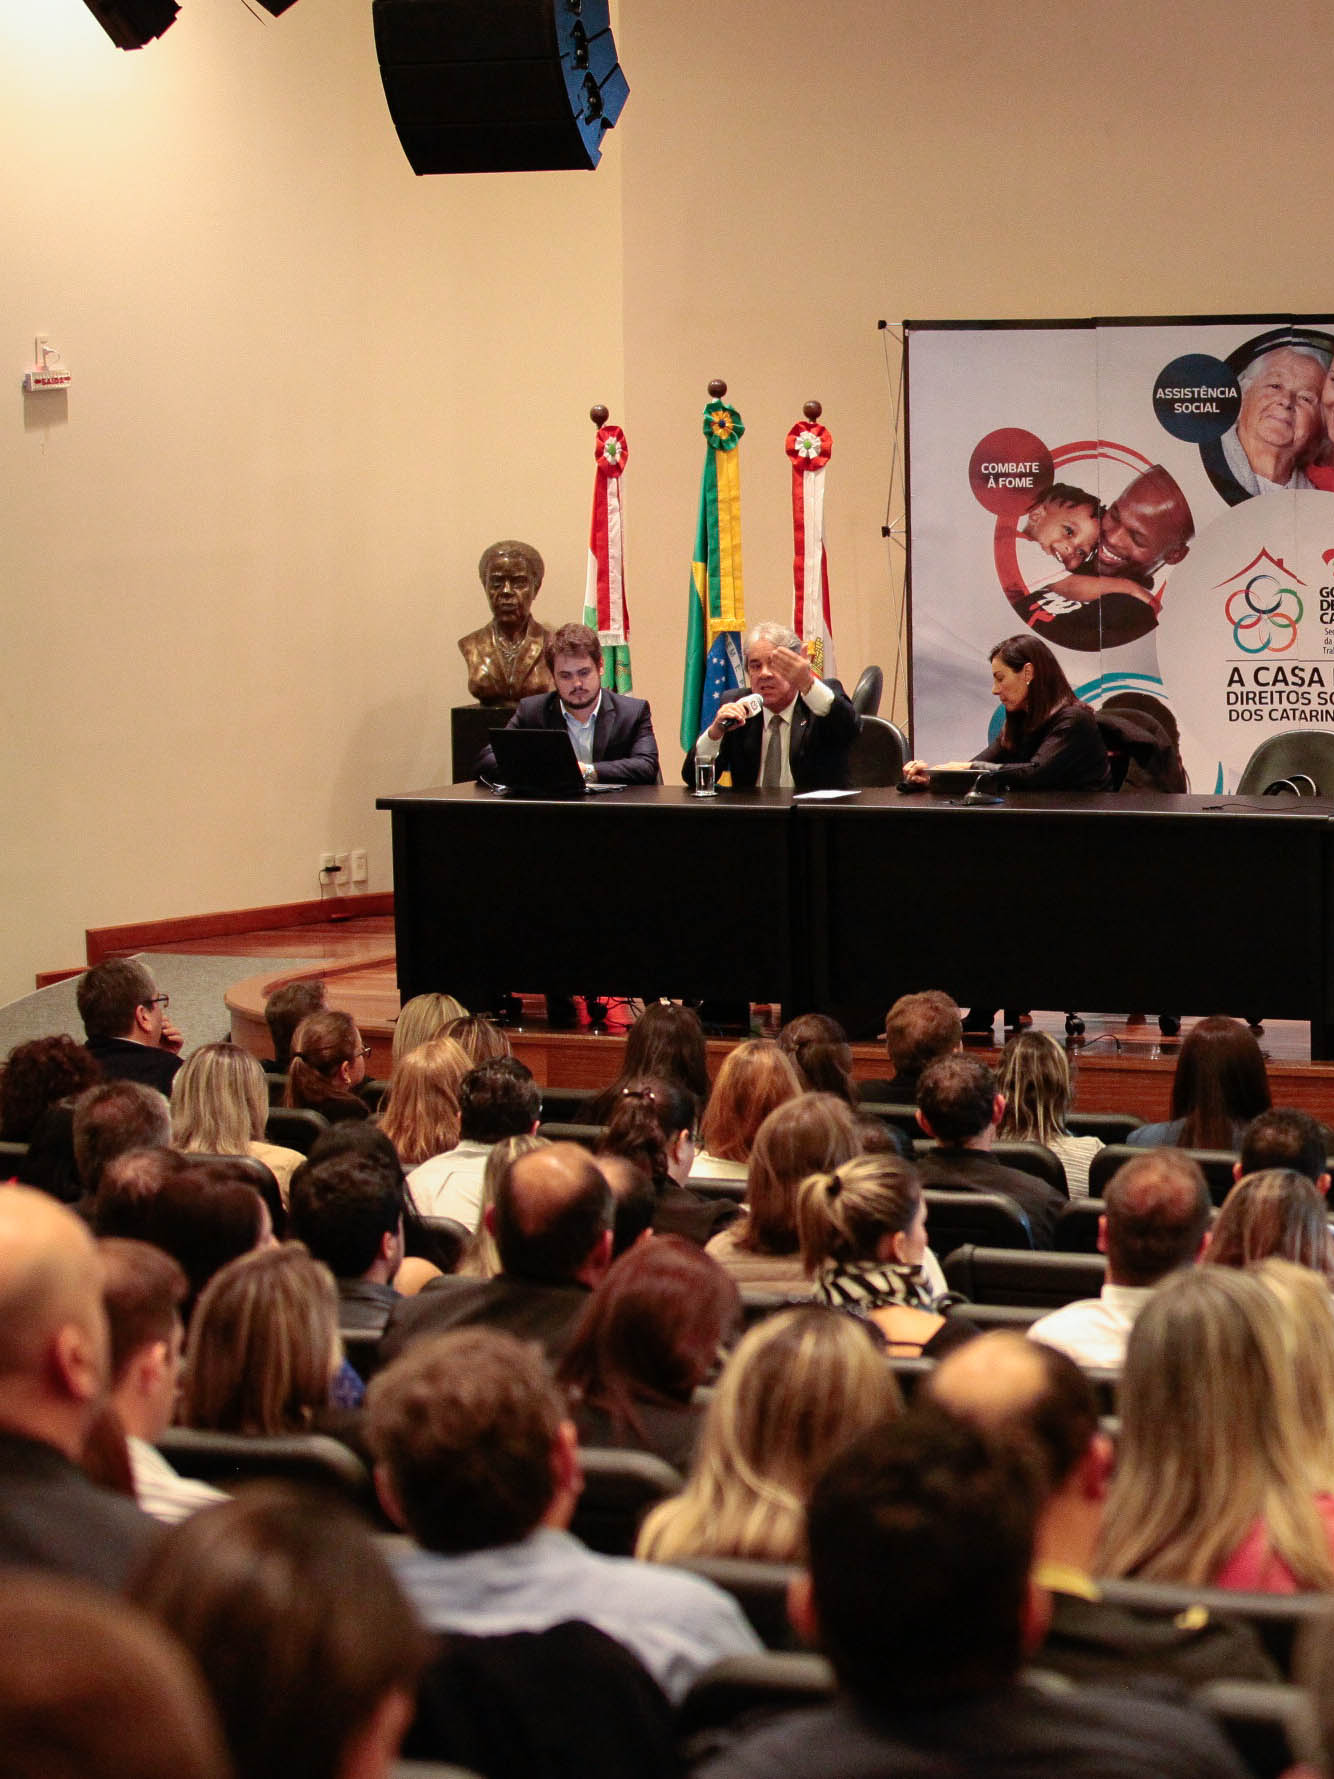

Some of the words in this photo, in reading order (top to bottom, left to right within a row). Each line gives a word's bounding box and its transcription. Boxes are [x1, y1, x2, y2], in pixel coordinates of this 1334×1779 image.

[1156, 385, 1238, 399] ASSISTÊNCIA
[1174, 402, 1220, 413] SOCIAL
[981, 462, 1040, 474] COMBATE
[987, 475, 996, 488] À
[999, 477, 1034, 488] FOME
[1324, 637, 1333, 645] da
[1227, 667, 1246, 687] A
[1253, 666, 1325, 688] CASA
[1226, 691, 1312, 706] DIREITOS
[1228, 708, 1264, 722] DOS
